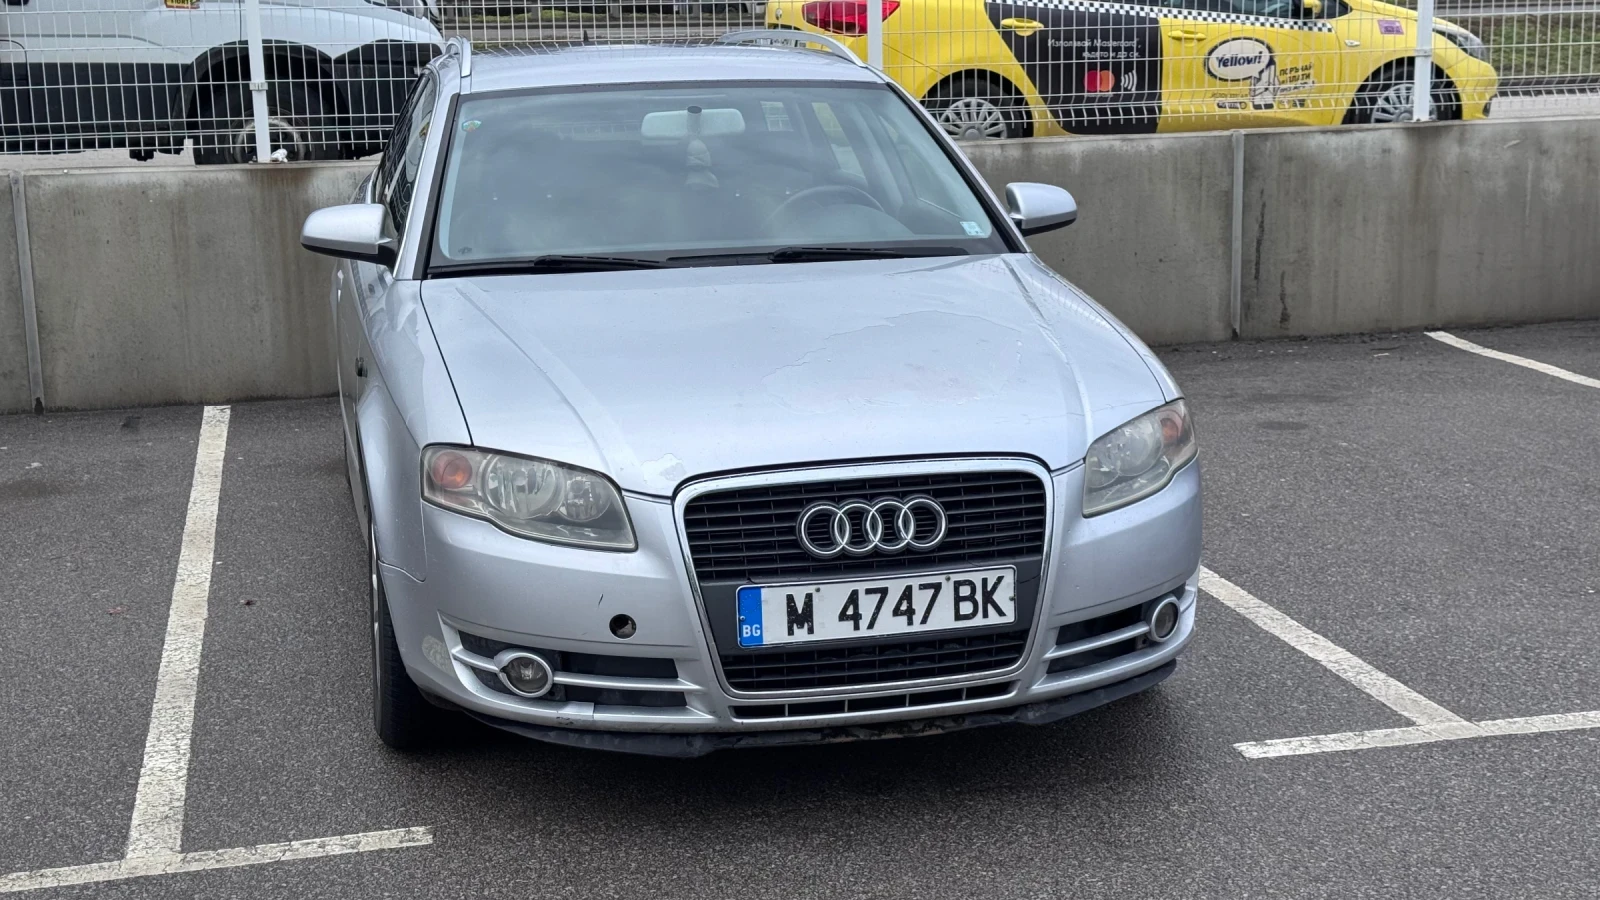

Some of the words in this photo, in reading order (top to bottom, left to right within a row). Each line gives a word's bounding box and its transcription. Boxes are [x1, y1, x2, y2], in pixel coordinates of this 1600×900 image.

[1048, 39, 1092, 47] Изполвай
[785, 592, 815, 636] M
[838, 581, 943, 631] 4747
[953, 575, 1006, 622] BK
[742, 624, 761, 638] BG
